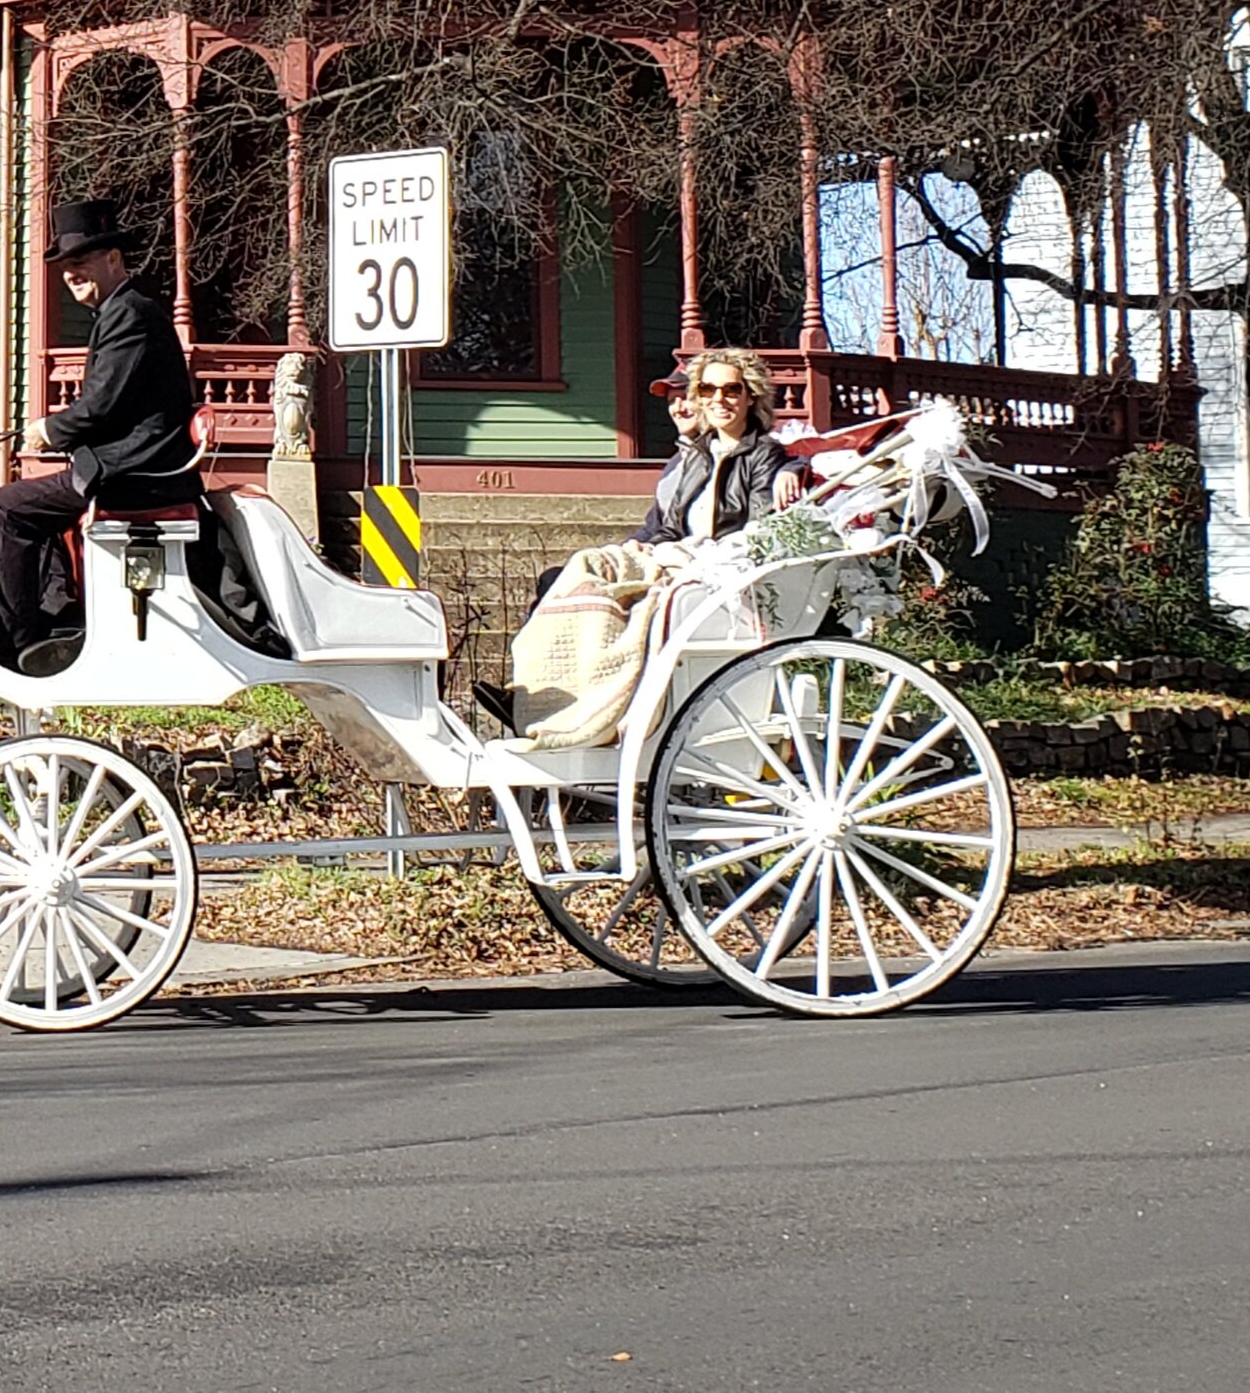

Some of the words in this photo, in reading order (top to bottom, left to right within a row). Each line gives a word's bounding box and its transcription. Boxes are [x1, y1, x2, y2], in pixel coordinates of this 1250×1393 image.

[342, 176, 435, 208] SPEED
[353, 215, 424, 246] LIMIT
[355, 257, 419, 331] 30
[476, 470, 515, 489] 401
